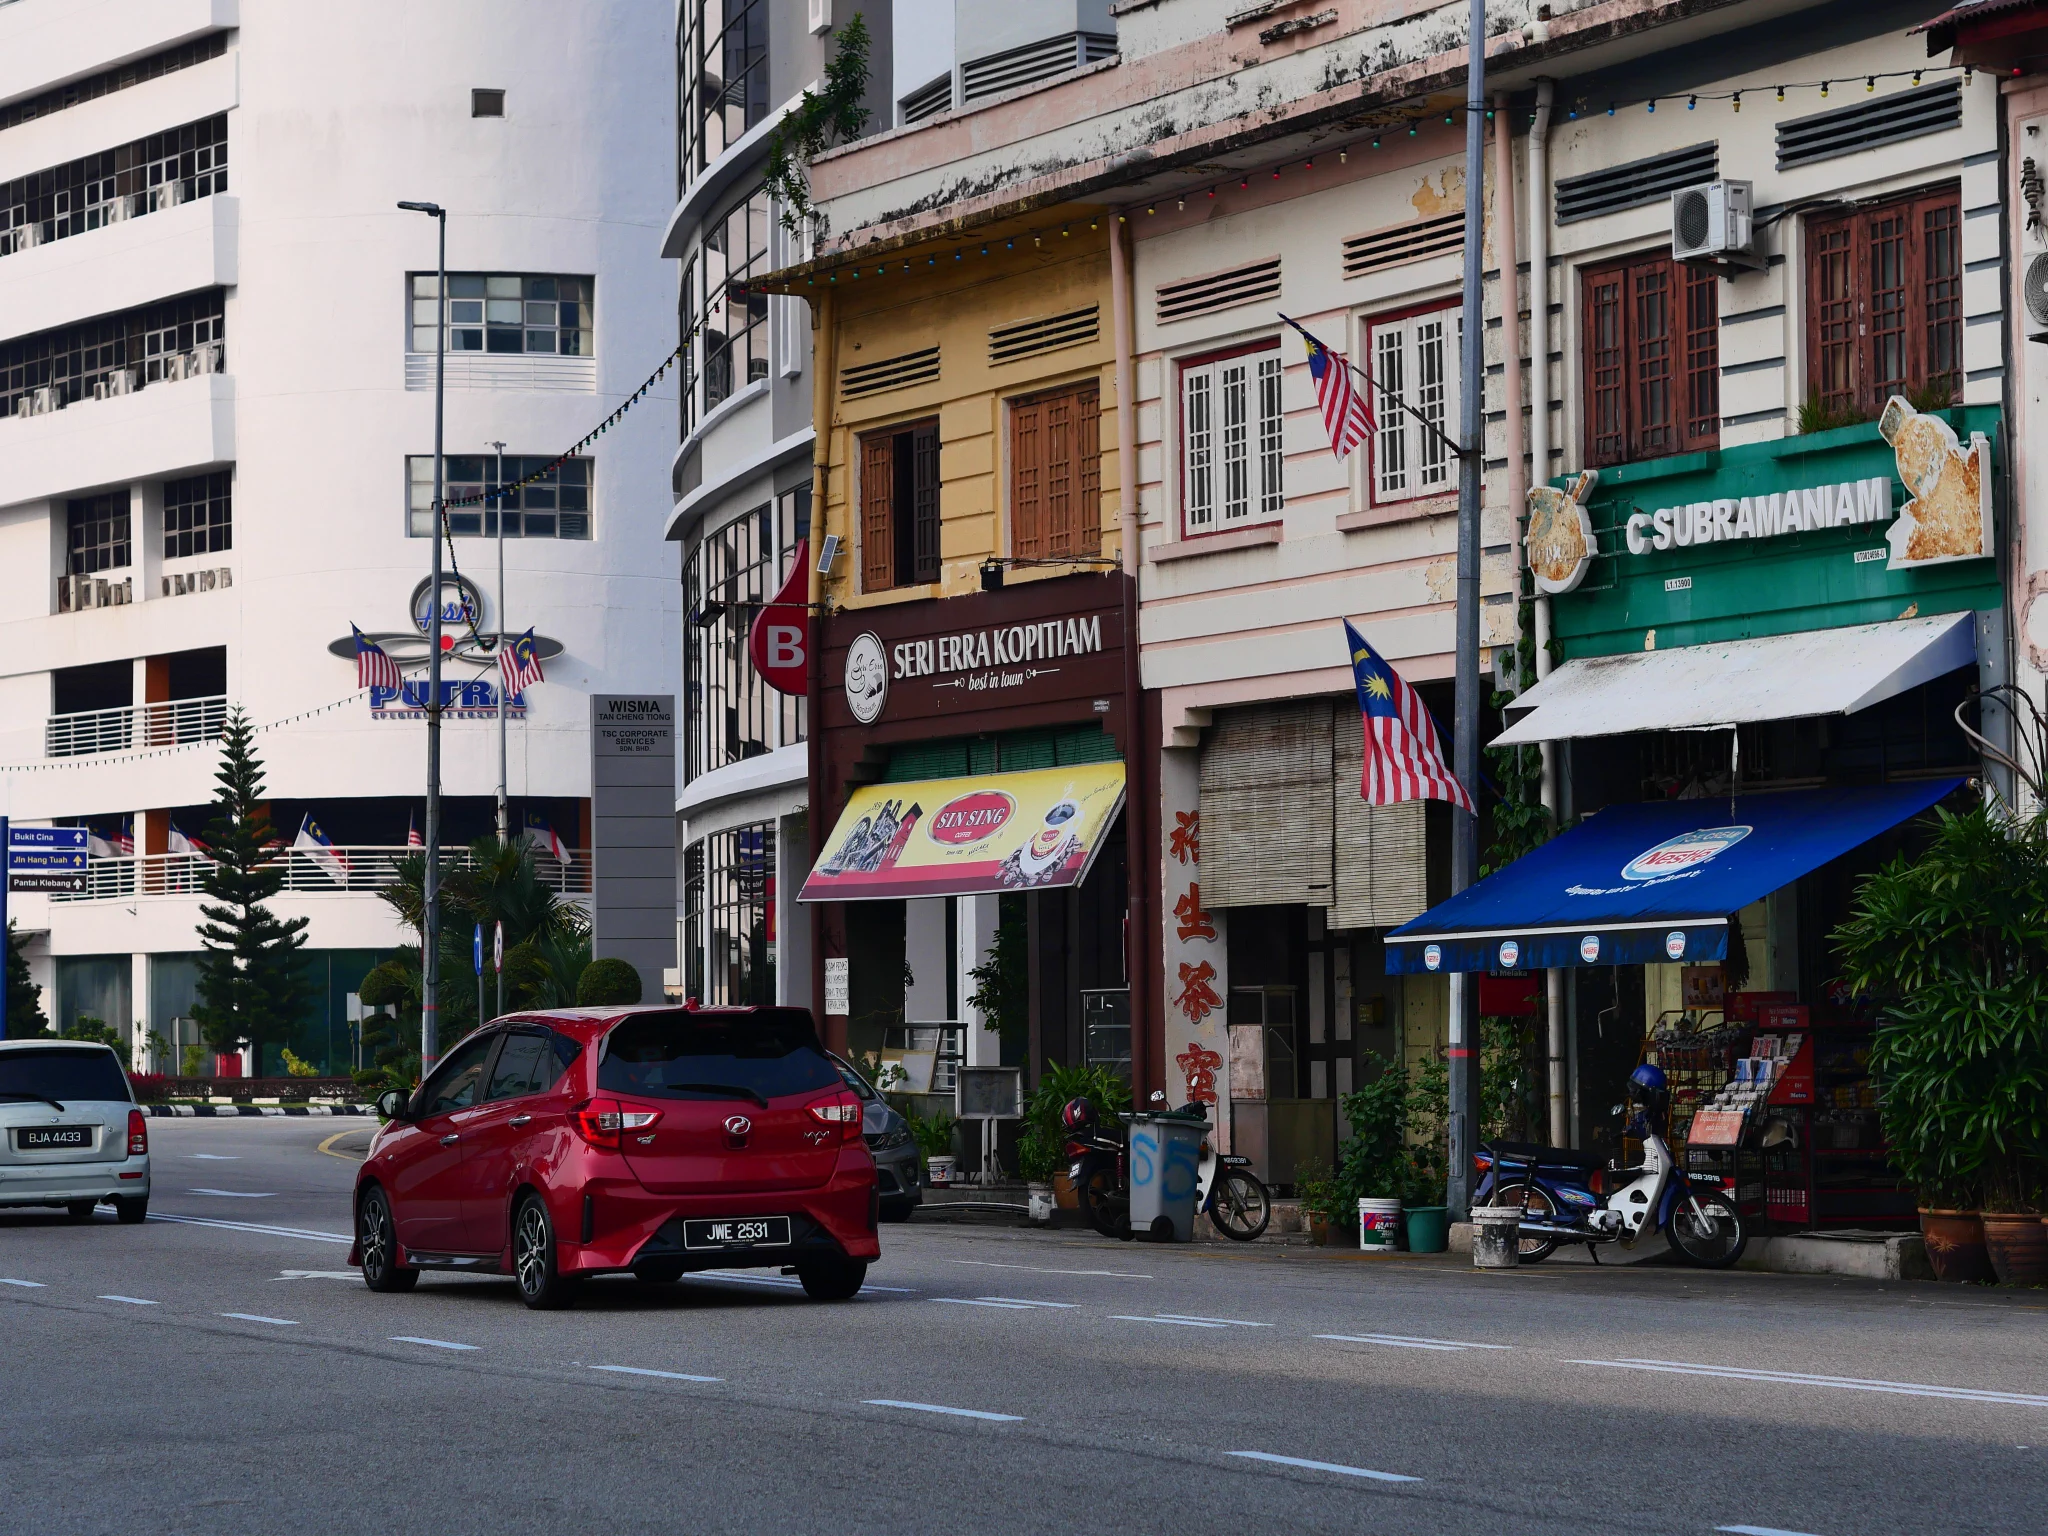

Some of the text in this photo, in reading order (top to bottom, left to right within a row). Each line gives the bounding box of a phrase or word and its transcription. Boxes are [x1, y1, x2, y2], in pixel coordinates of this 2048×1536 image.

[1626, 477, 1888, 555] C SUBRAMANIAM
[767, 625, 805, 668] B
[894, 615, 1102, 679] SERI ERRA KOPITIAM
[968, 671, 1024, 691] best in town
[608, 700, 660, 713] WISMA
[937, 807, 1006, 829] SIN SING
[36, 833, 54, 841] Cina
[27, 856, 48, 865] Hang
[14, 879, 71, 889] Pantai Klebang
[29, 1131, 81, 1143] BJA 4433
[706, 1222, 768, 1240] JWE 2531
